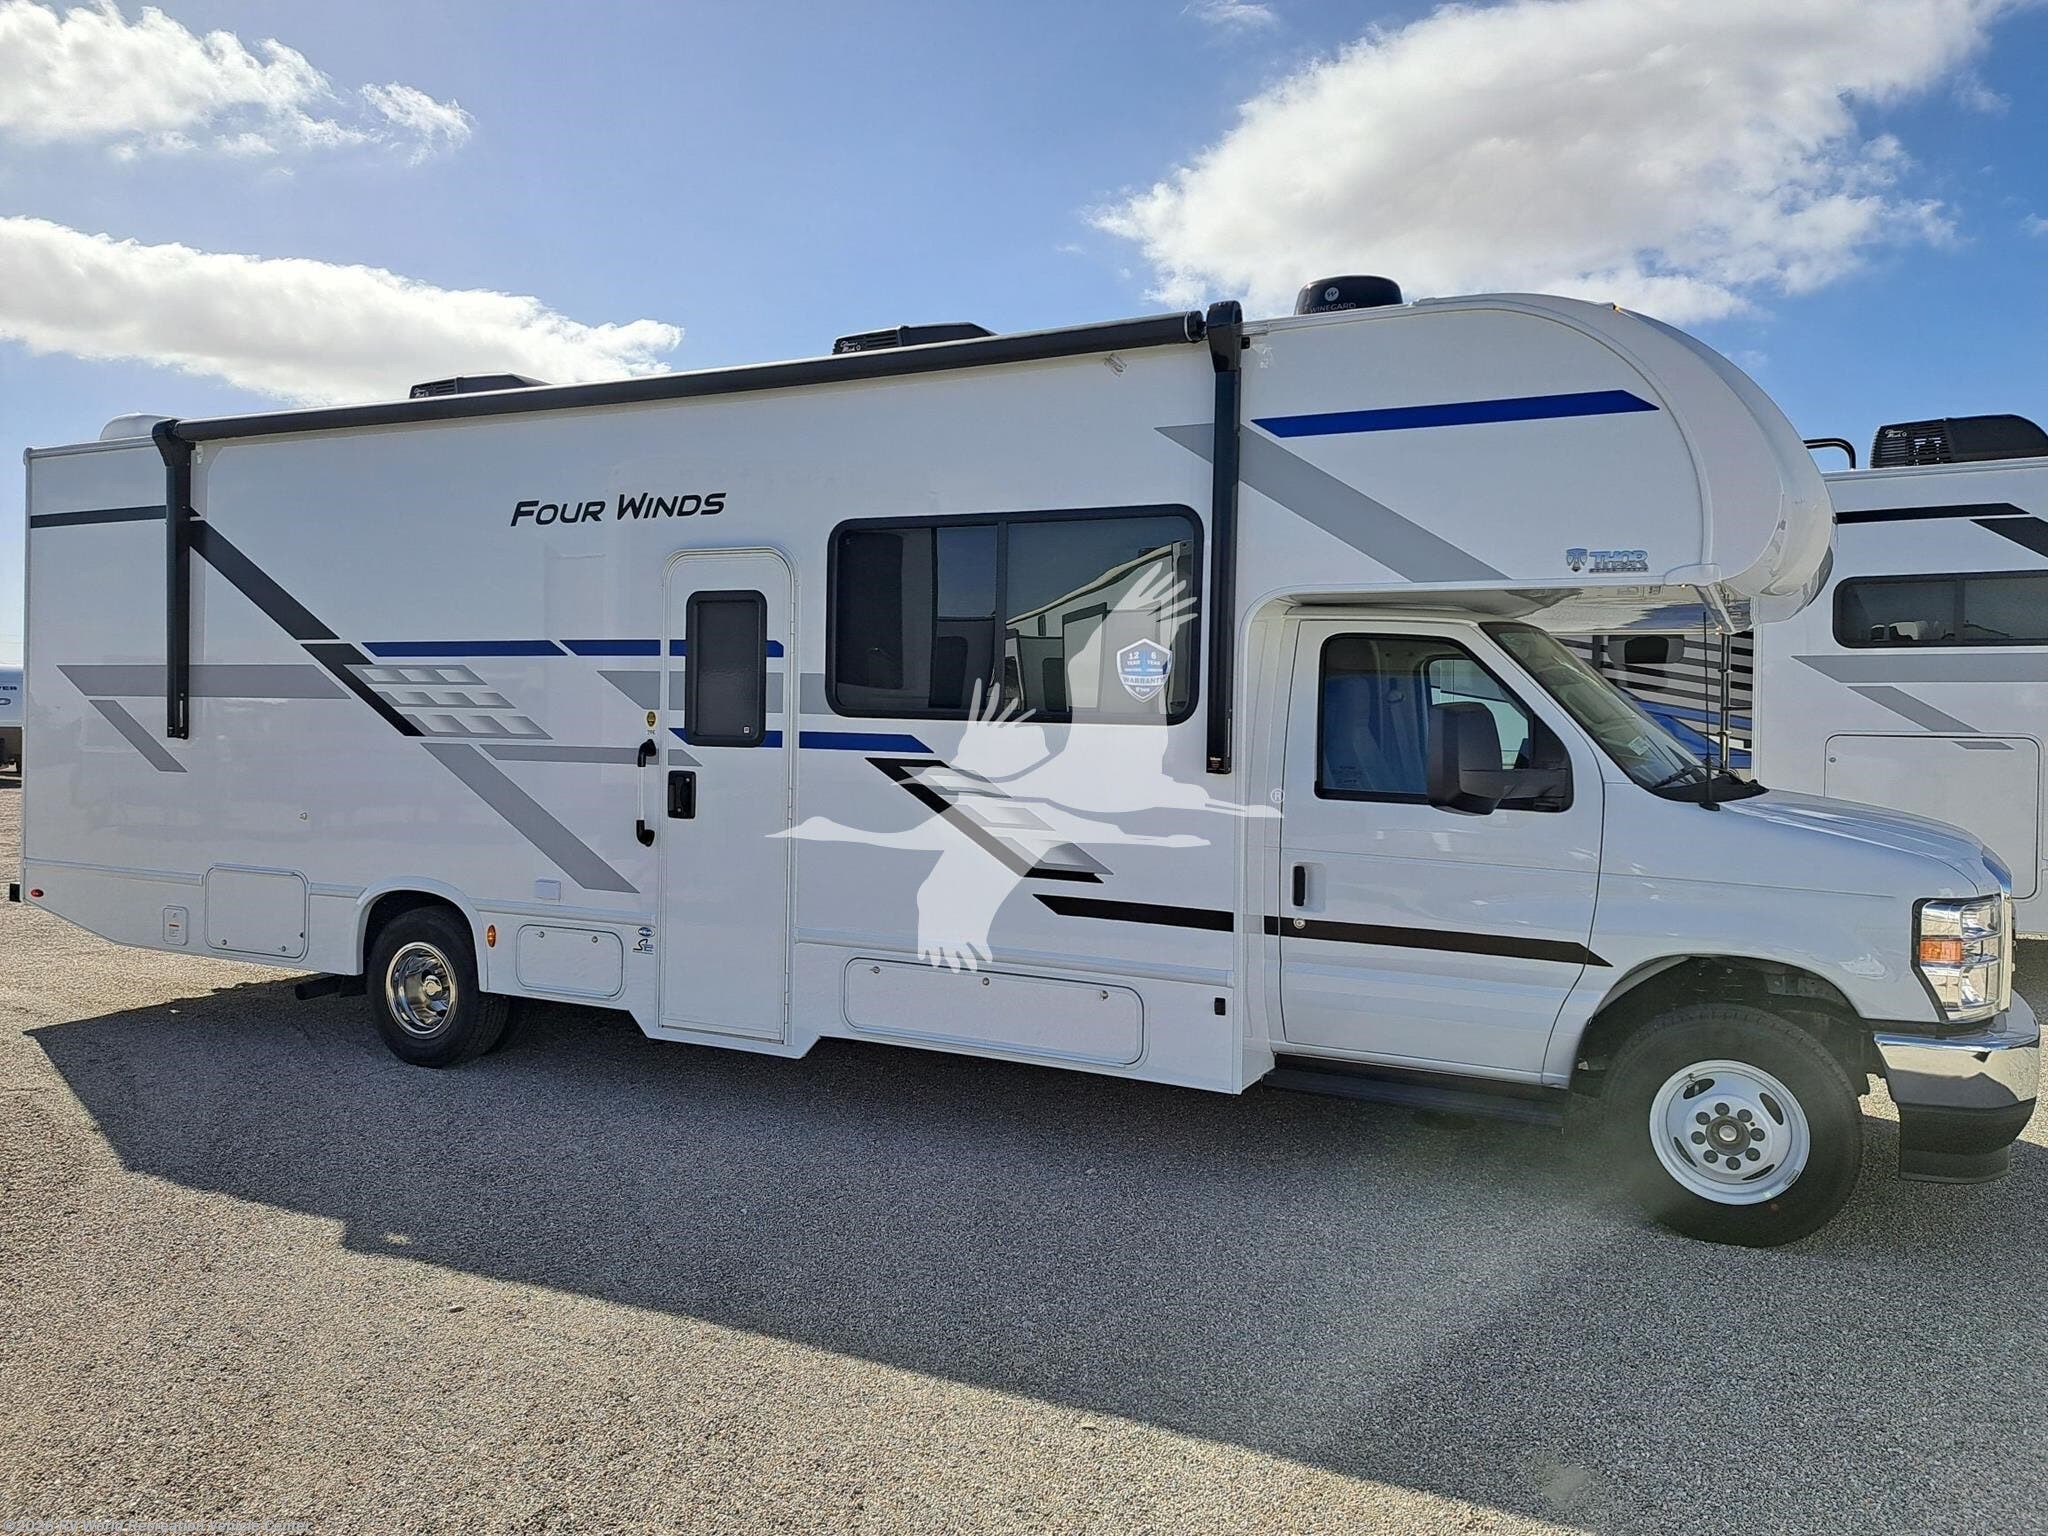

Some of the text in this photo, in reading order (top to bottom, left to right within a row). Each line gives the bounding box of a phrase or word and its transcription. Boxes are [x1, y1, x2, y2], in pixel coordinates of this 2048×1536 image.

[1309, 302, 1357, 313] WINEGARD
[1589, 550, 1649, 569] THOR
[1128, 651, 1140, 660] 12
[1151, 651, 1157, 660] 6
